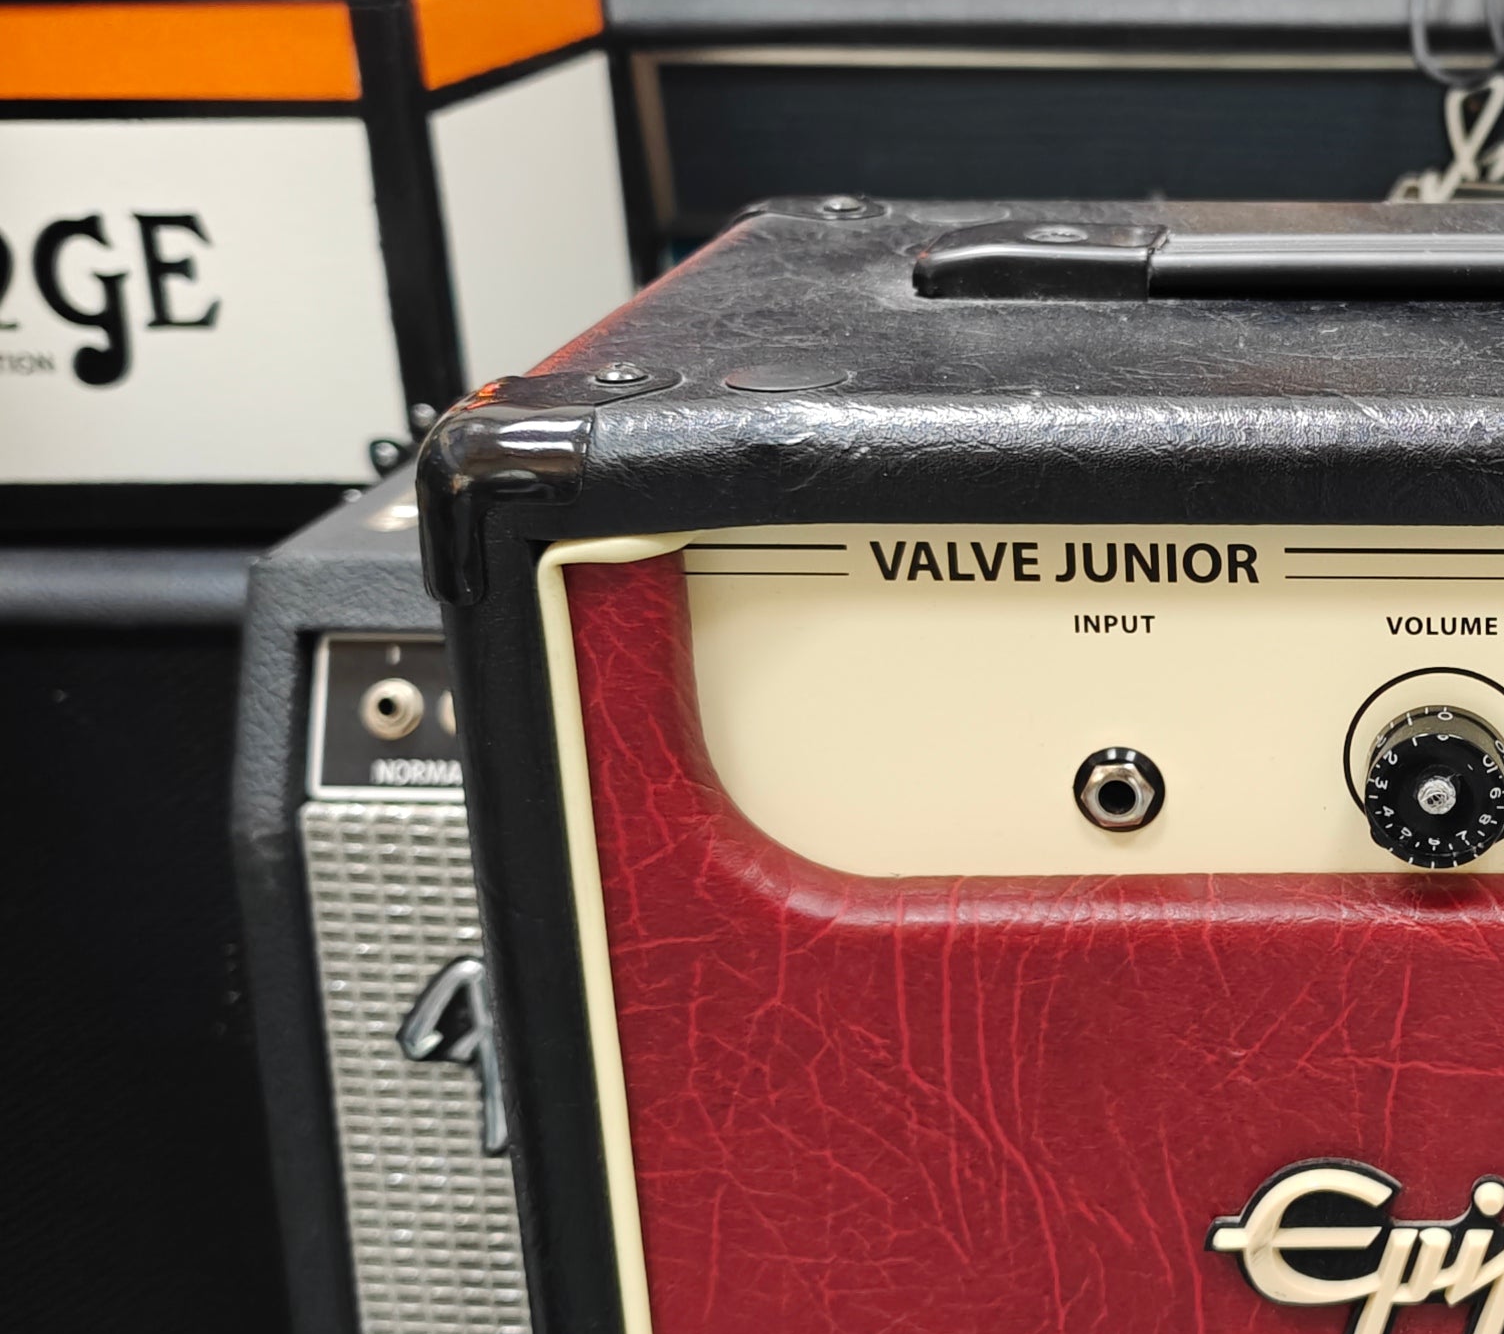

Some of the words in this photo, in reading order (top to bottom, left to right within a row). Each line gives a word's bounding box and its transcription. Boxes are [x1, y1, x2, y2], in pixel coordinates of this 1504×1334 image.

[869, 540, 1041, 582] VALVE
[1055, 542, 1260, 584] JUNIOR
[1074, 614, 1156, 634] INPUT
[1386, 616, 1498, 636] VOLUME
